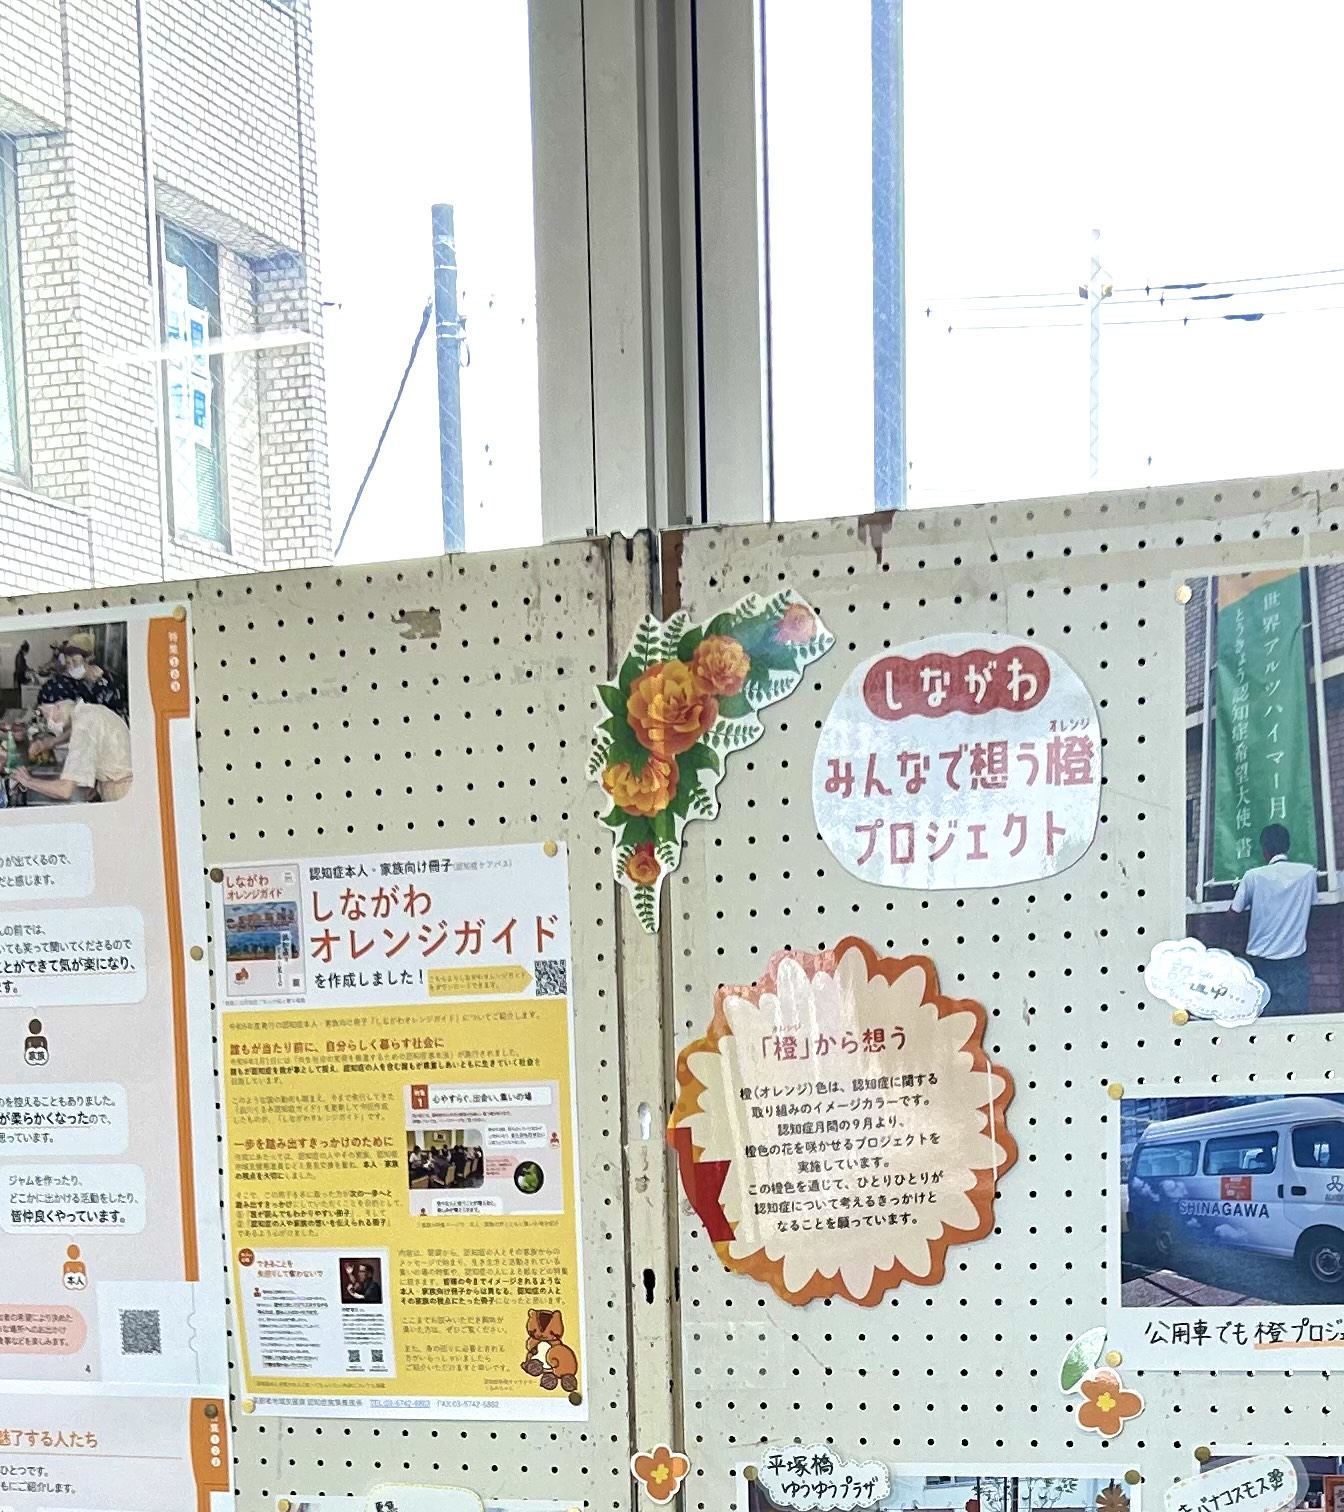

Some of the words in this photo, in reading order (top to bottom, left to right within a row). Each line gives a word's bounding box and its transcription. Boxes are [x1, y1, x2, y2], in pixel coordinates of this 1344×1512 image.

[885, 657, 1039, 711] しながわ
[1049, 718, 1090, 732] オレンジ
[824, 734, 1095, 800] みんなで想う橙
[855, 810, 1066, 866] プロジェクト
[226, 873, 269, 888] しながわ
[312, 883, 433, 923] しながわ
[310, 914, 559, 964] オレンジガイド
[314, 968, 424, 989] を作成しました！
[760, 1025, 908, 1062] 「橙」から想う
[777, 1114, 905, 1137] 認知症月間の9月より、
[797, 1155, 890, 1174] 実施しています。
[754, 1191, 938, 1216] 認知症について考えるきっかけと
[1178, 1199, 1270, 1219] SHINAGAWA
[776, 1210, 919, 1233] なることを願っています。
[766, 1454, 834, 1477] 平塚橋
[781, 1476, 879, 1501] ゆうゆうプラザ
